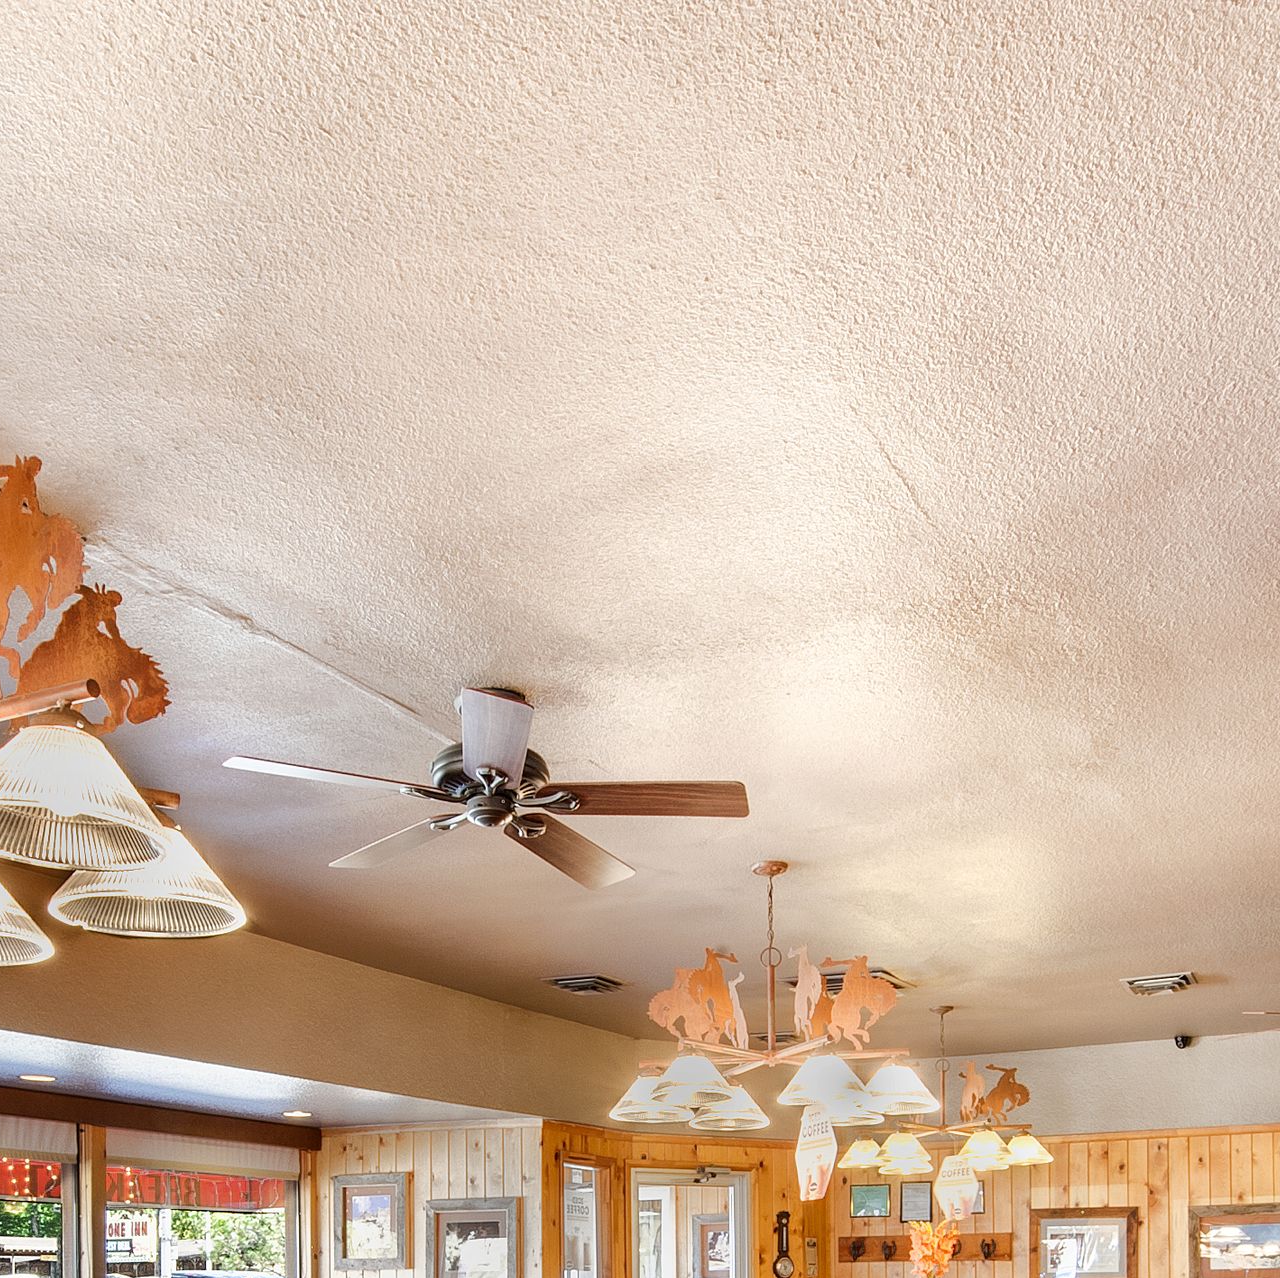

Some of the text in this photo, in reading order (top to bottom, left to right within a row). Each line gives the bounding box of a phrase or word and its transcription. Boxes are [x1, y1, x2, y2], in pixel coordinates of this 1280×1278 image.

[802, 1120, 829, 1138] COFFEE
[941, 1167, 971, 1178] COFFEE
[108, 1221, 148, 1238] ONE INN
